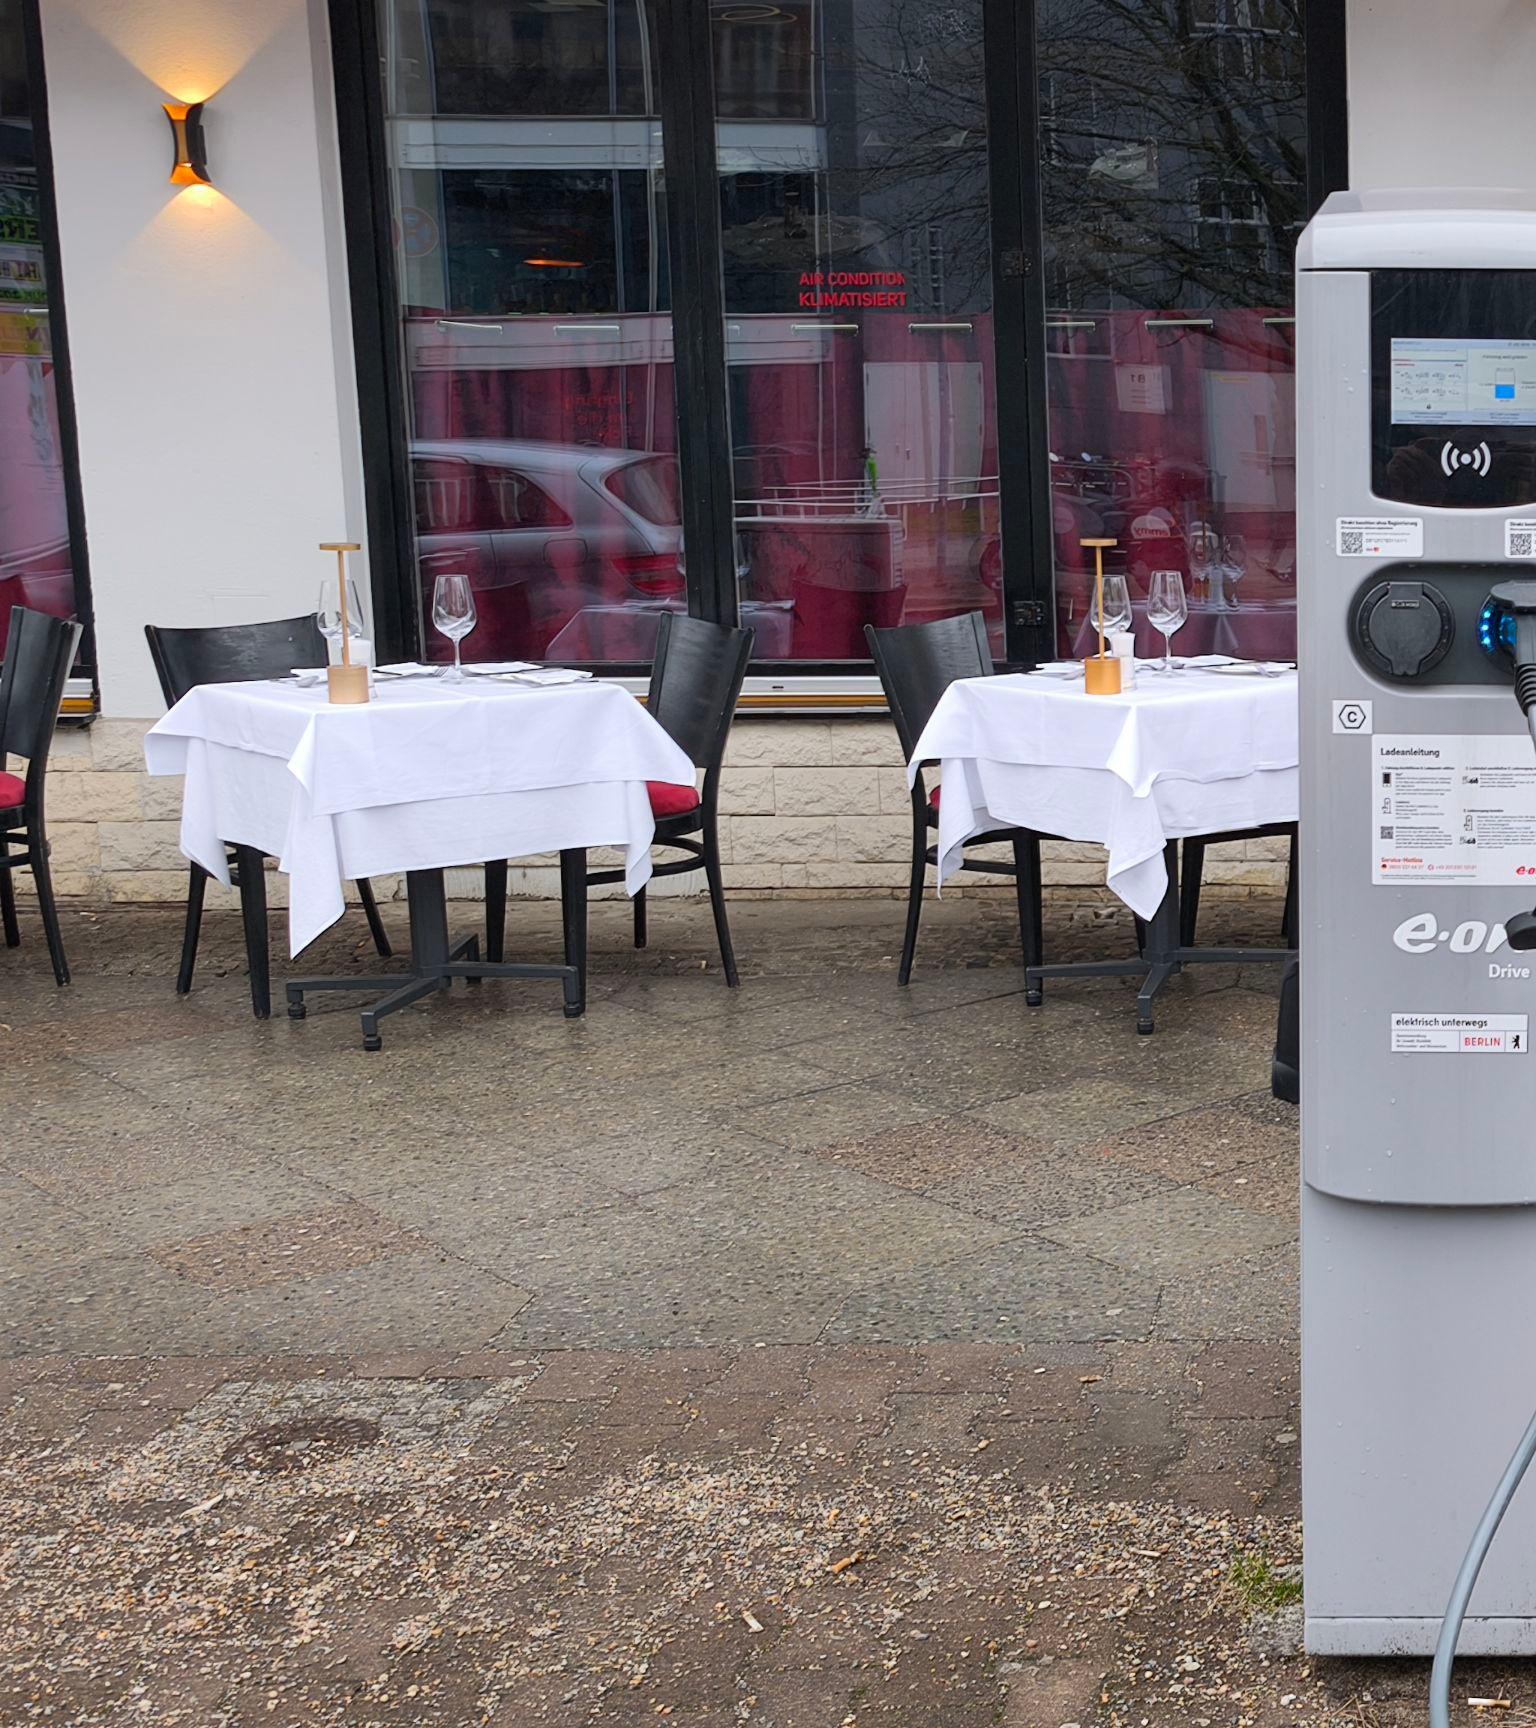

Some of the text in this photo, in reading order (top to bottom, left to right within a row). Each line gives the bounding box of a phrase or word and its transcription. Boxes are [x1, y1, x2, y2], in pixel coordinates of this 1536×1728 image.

[800, 272, 906, 286] AIR CONDITION
[799, 292, 907, 307] KLIMATISIERT
[1347, 711, 1357, 723] C
[1380, 748, 1440, 758] Ladeanleitung
[1489, 964, 1531, 978] Drive
[1396, 1018, 1488, 1028] elektrisch unterwegs
[1464, 1037, 1501, 1046] BERLIN
